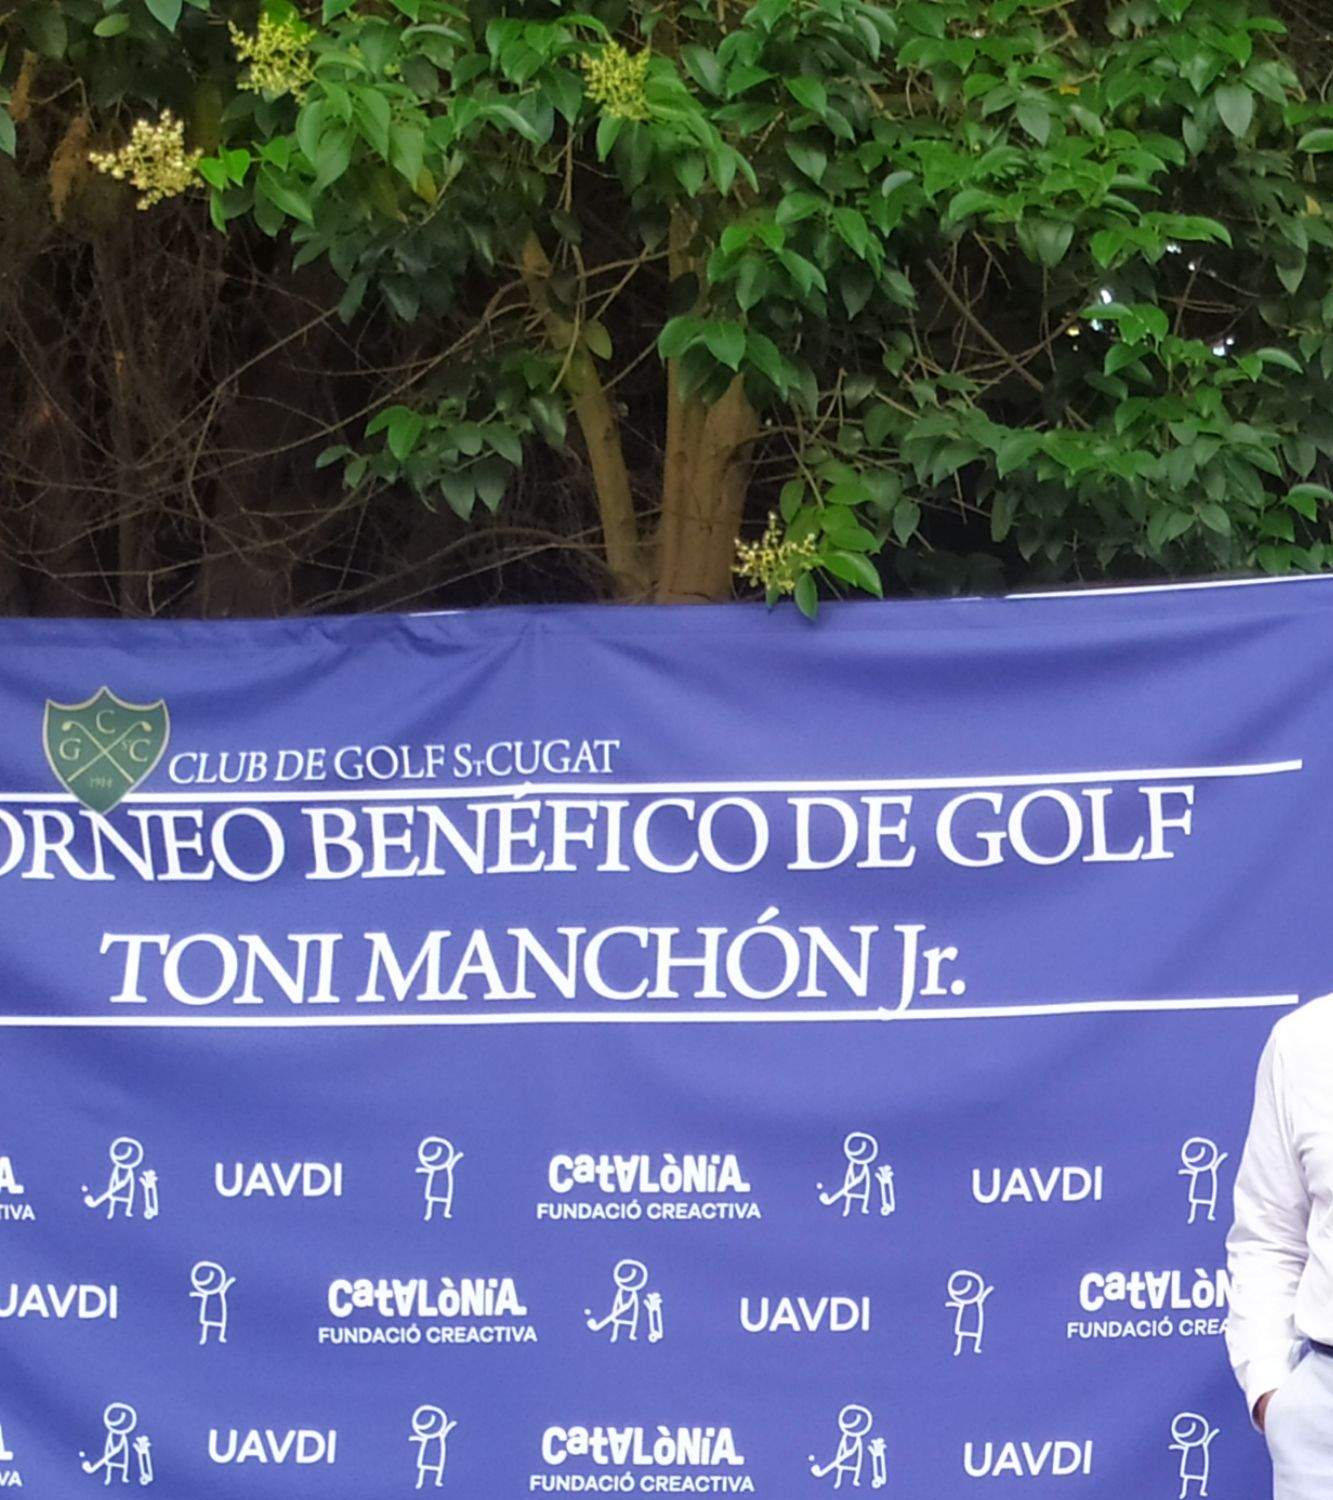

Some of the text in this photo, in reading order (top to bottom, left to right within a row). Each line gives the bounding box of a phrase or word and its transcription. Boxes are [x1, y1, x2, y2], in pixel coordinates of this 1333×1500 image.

[169, 752, 267, 783] CLUB
[274, 749, 325, 781] DE
[335, 745, 444, 779] GOLF
[306, 783, 770, 880] BENÉFICO
[789, 798, 915, 870] DE
[936, 785, 1195, 867] GOLF
[100, 906, 967, 1013] TONI MANCHÓN Jr.
[216, 1163, 342, 1196] UAVDI
[973, 1166, 1102, 1203] UAVDI
[537, 1199, 761, 1219] FUNDACIÓ CREACTIVA
[741, 1297, 869, 1332] UAVDI
[1068, 1316, 1173, 1338] FUNDACIÓ
[319, 1324, 537, 1343] FUNDACIÓ CREACTIVA
[209, 1429, 336, 1463] UAVDI
[964, 1440, 1092, 1476] UAVDI
[530, 1472, 754, 1492] FUNDACIÓ CREACTIVA
